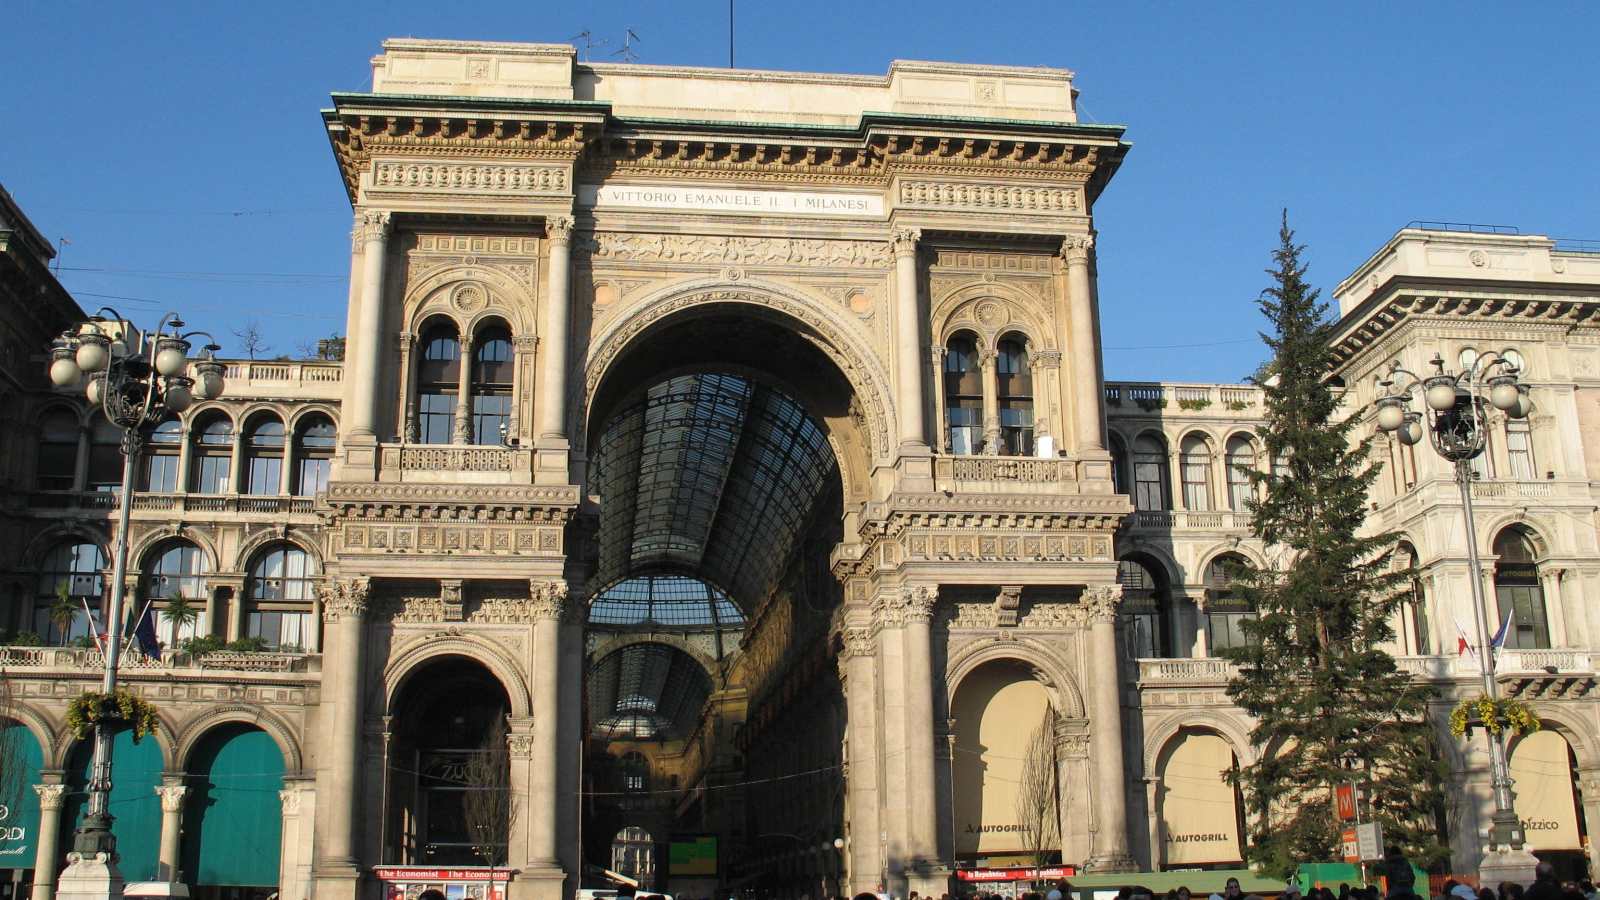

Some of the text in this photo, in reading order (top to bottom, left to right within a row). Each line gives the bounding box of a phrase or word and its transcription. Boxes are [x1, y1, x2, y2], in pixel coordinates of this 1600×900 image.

[613, 192, 677, 203] VITTORIO
[685, 193, 761, 206] EMANUELE
[806, 198, 869, 209] MILANESI
[1340, 793, 1352, 812] M
[976, 824, 1032, 833] AUTOGRILL
[1175, 834, 1229, 843] AUTOGRILL
[396, 870, 439, 878] Economist
[465, 870, 507, 878] Economist
[974, 869, 1006, 879] Repubblica
[1032, 868, 1064, 878] Rpubblica
